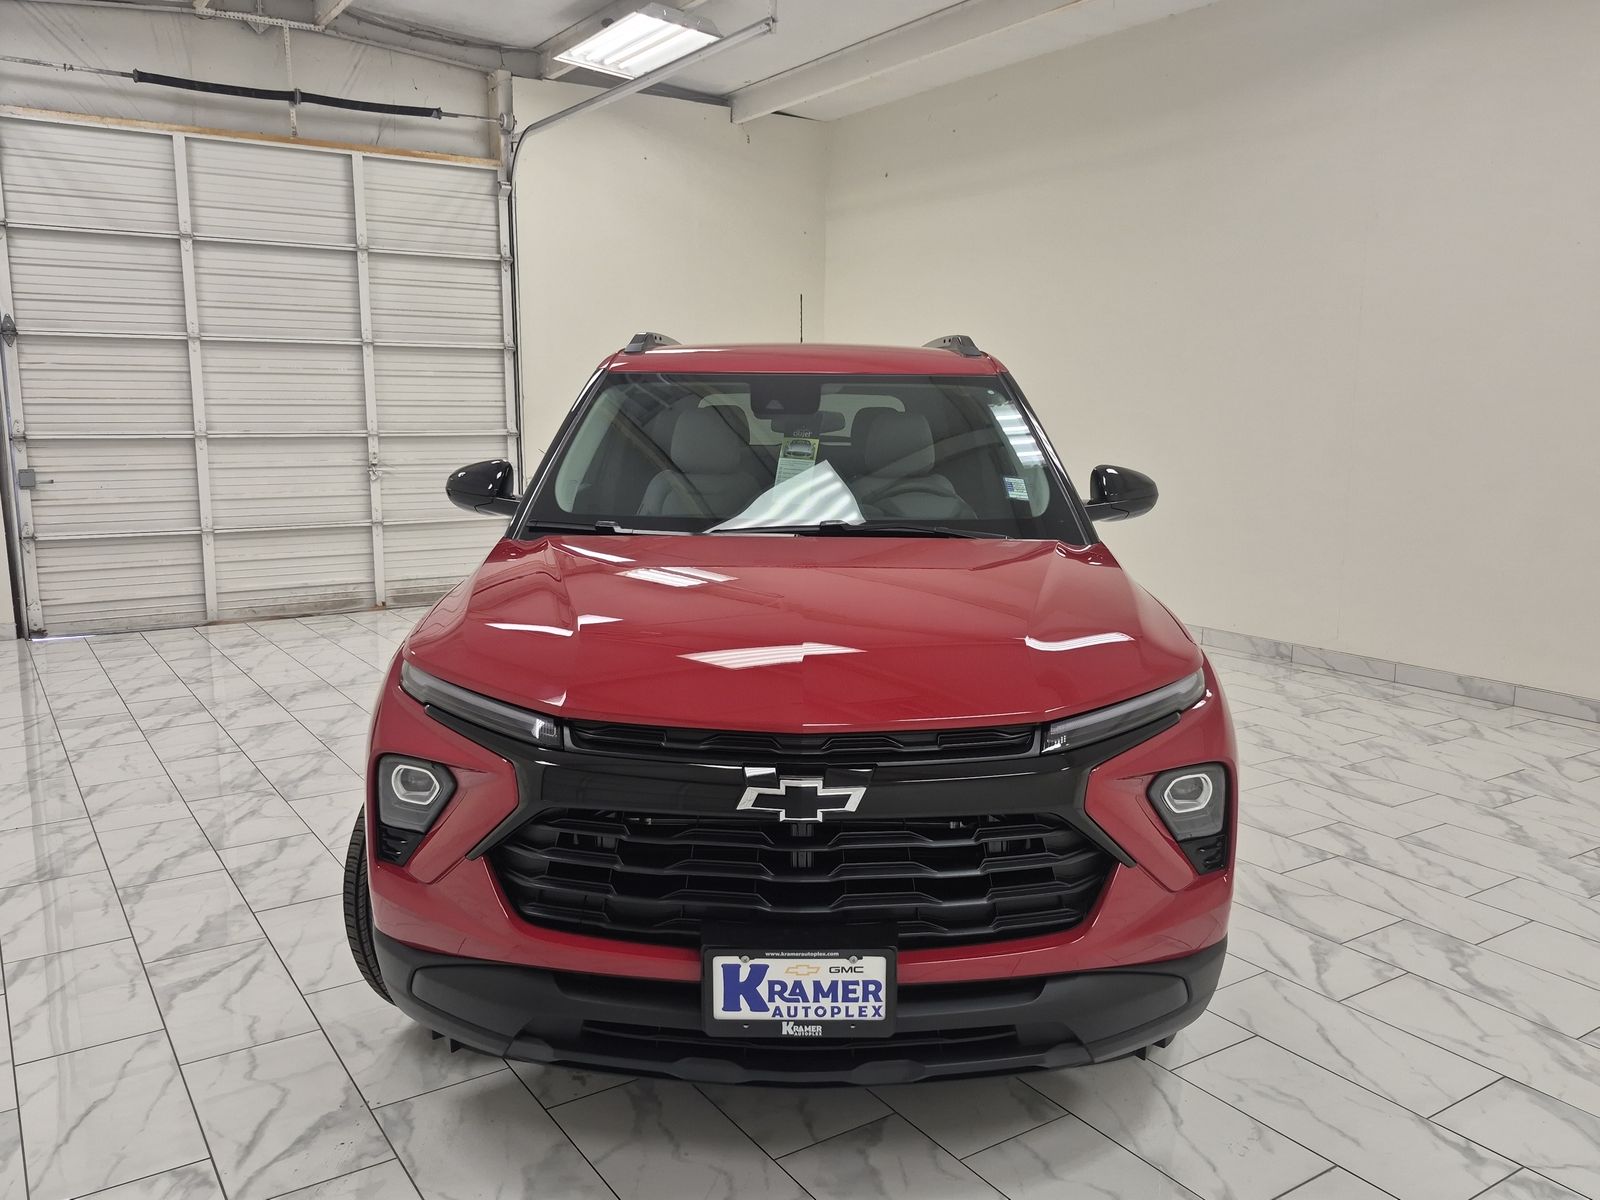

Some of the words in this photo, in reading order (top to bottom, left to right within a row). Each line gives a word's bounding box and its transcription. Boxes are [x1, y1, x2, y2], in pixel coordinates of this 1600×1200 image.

[828, 966, 865, 974] GMC
[721, 963, 883, 1012] KRAMER
[771, 1005, 883, 1018] AUTOPLEX
[781, 1021, 822, 1035] KRAMER
